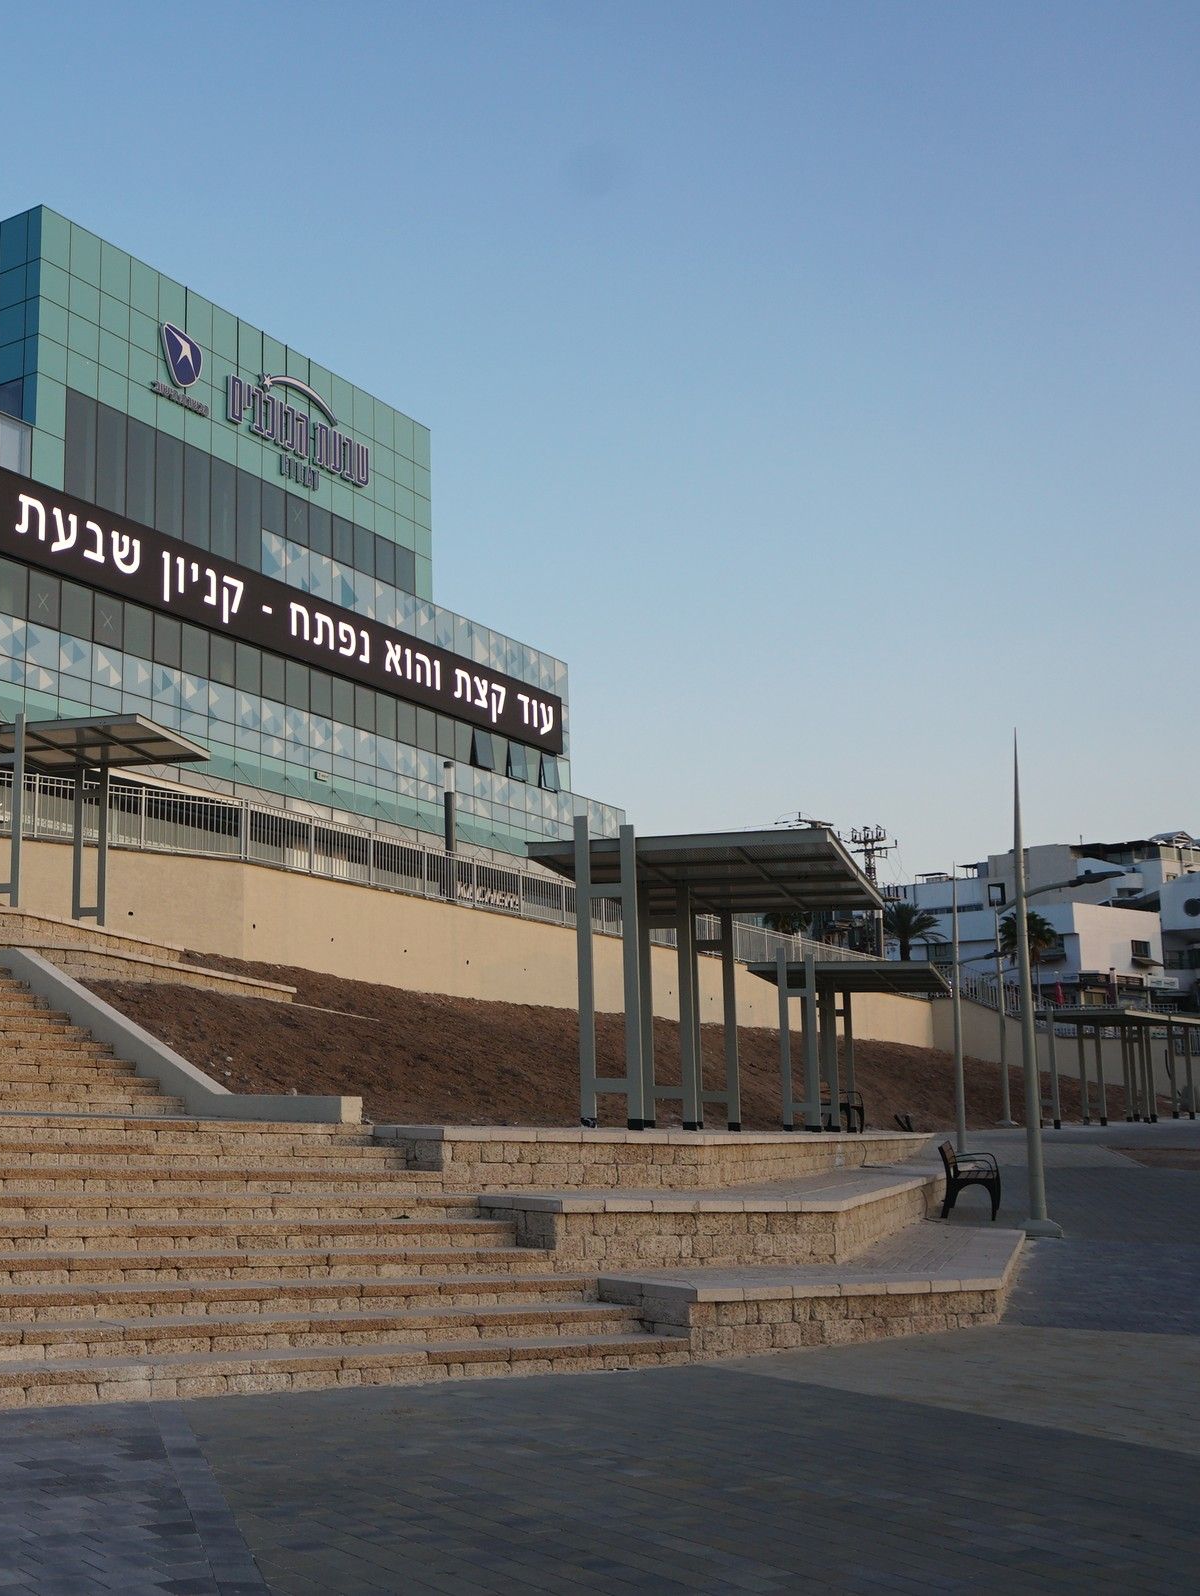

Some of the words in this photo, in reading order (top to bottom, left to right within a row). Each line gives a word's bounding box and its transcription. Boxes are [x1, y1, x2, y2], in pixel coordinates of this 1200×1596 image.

[226, 373, 310, 460] הכוכבים
[313, 421, 370, 488] שבעת
[15, 493, 141, 574] שבעת
[162, 549, 244, 624] קניון
[289, 601, 370, 664] נפתח
[385, 629, 441, 691] והוא
[453, 667, 506, 723] קצת
[517, 692, 555, 735] עוד
